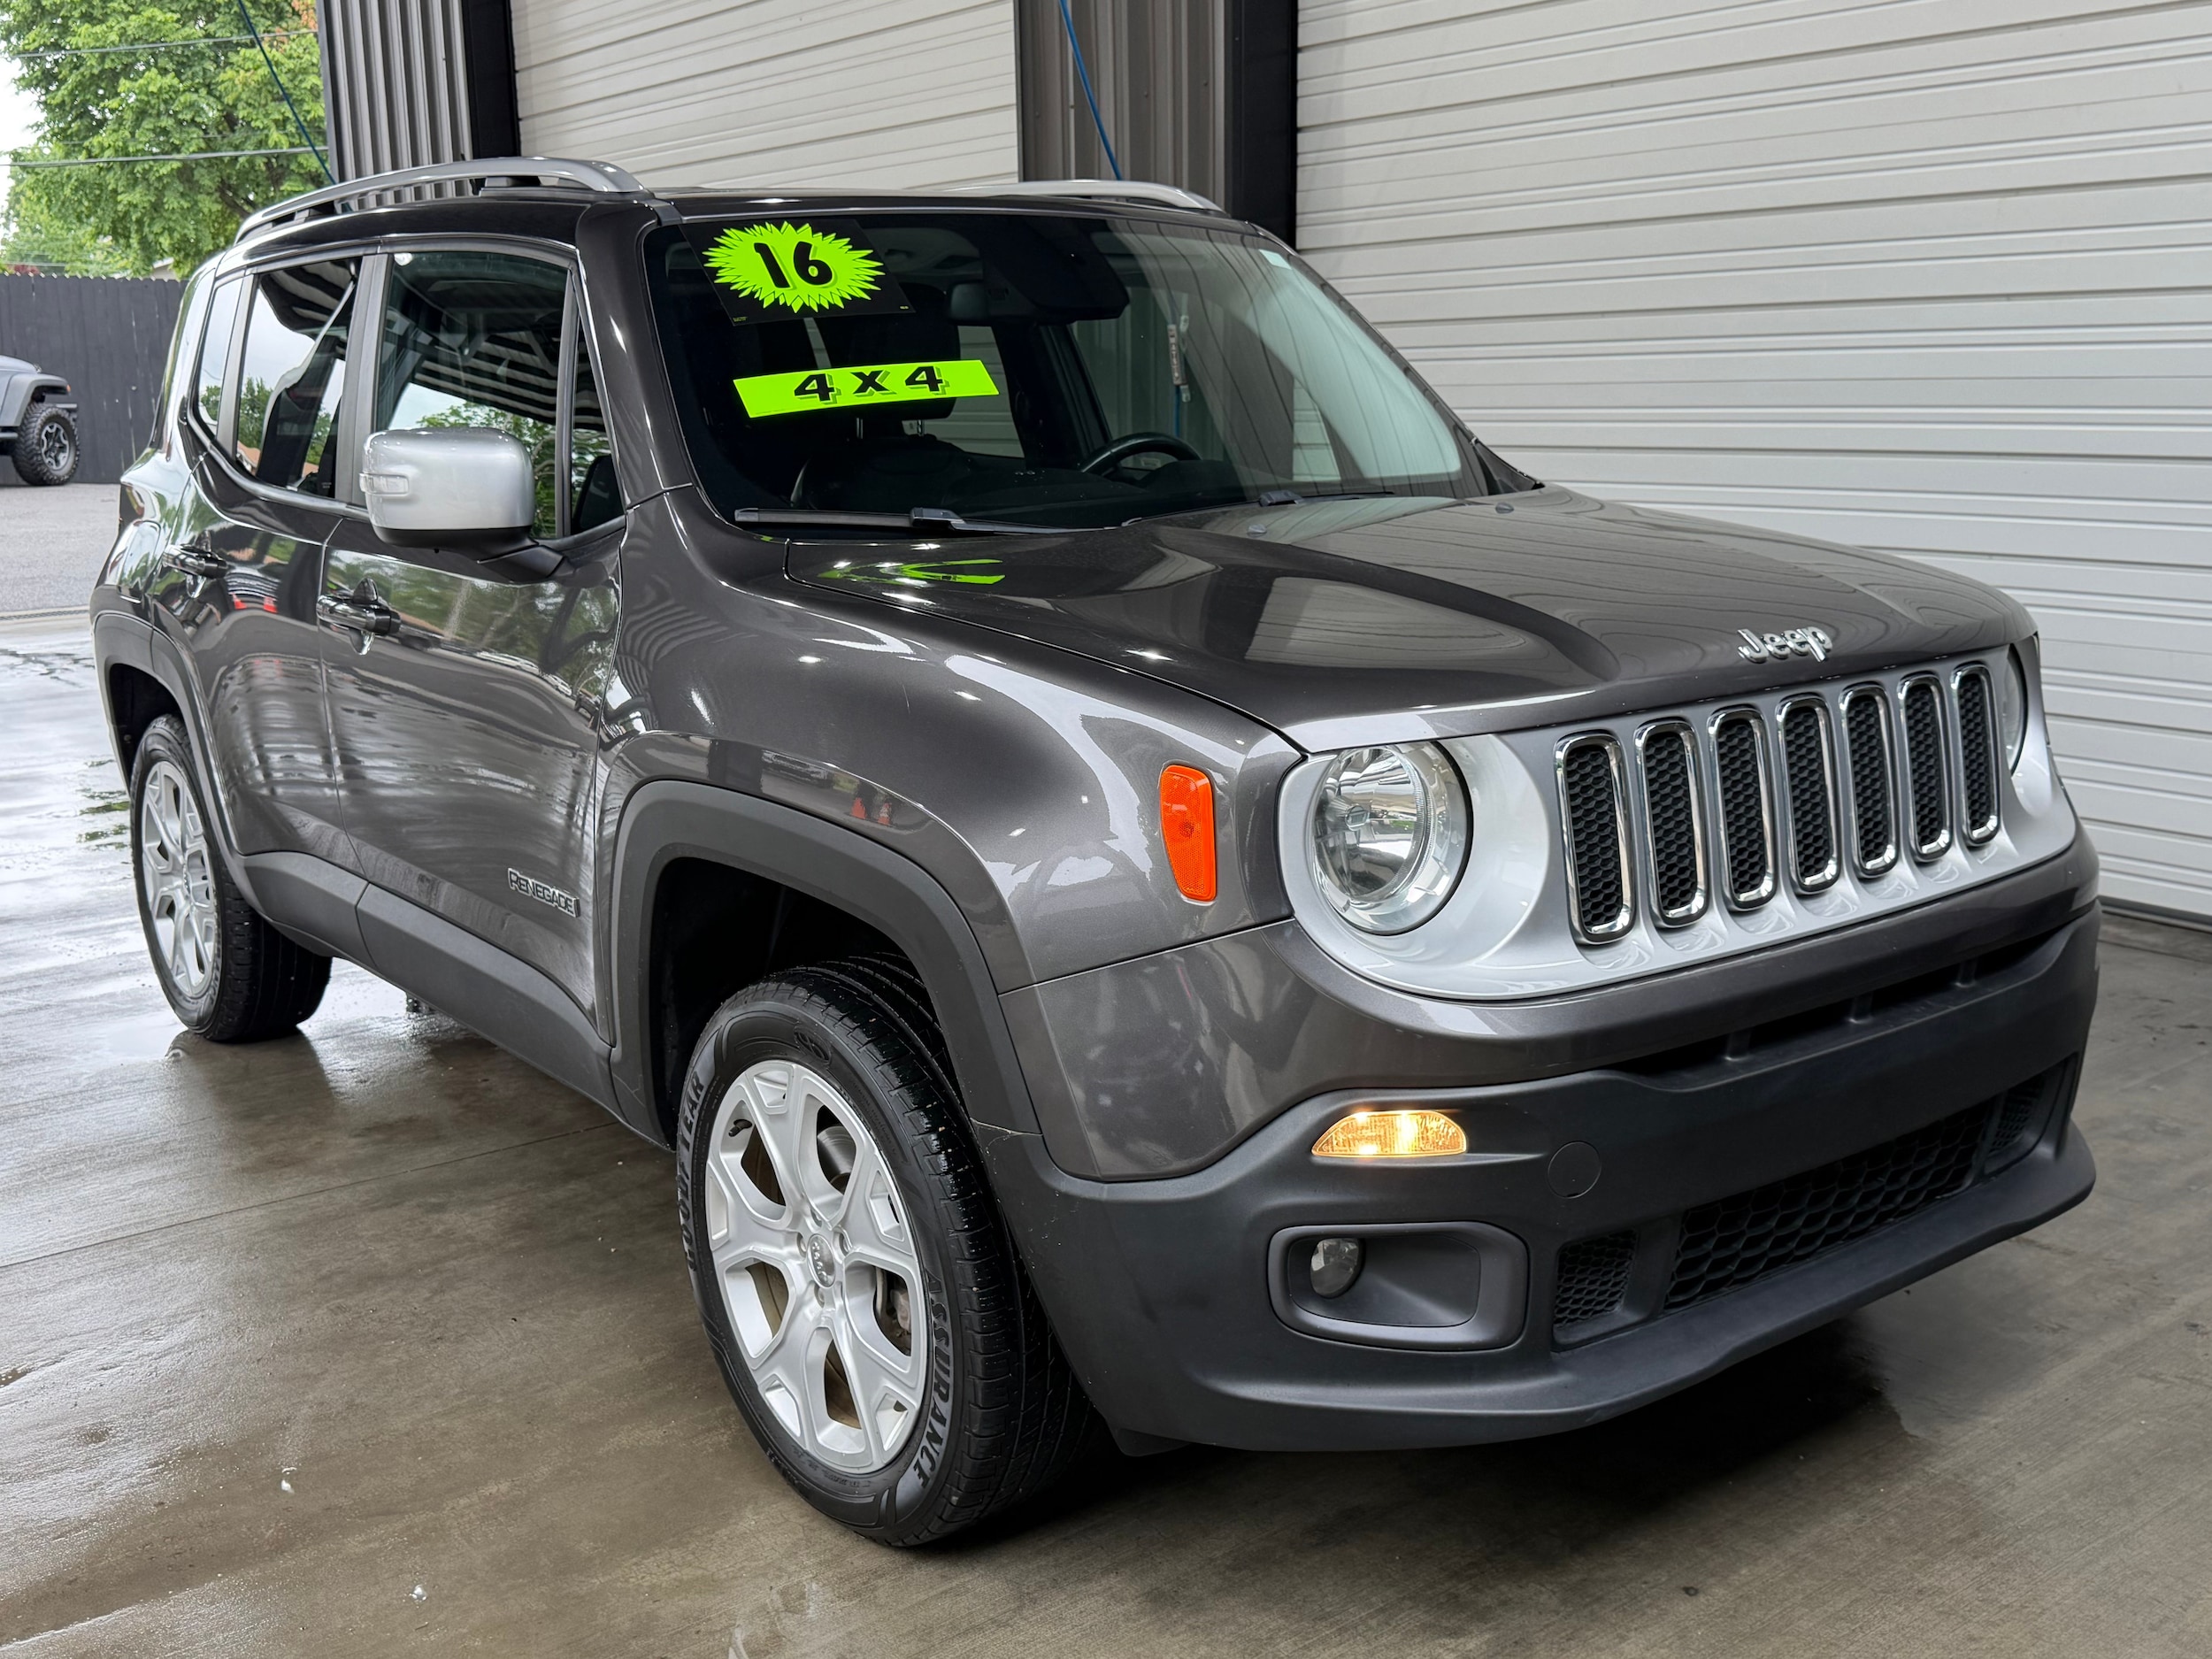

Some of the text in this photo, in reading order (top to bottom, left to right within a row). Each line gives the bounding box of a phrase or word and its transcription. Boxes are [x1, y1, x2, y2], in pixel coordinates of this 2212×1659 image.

[754, 241, 833, 289] 16
[1737, 626, 1833, 664] Jeep
[508, 868, 580, 918] RENEGADE
[913, 1266, 951, 1489] ASSURANCE
